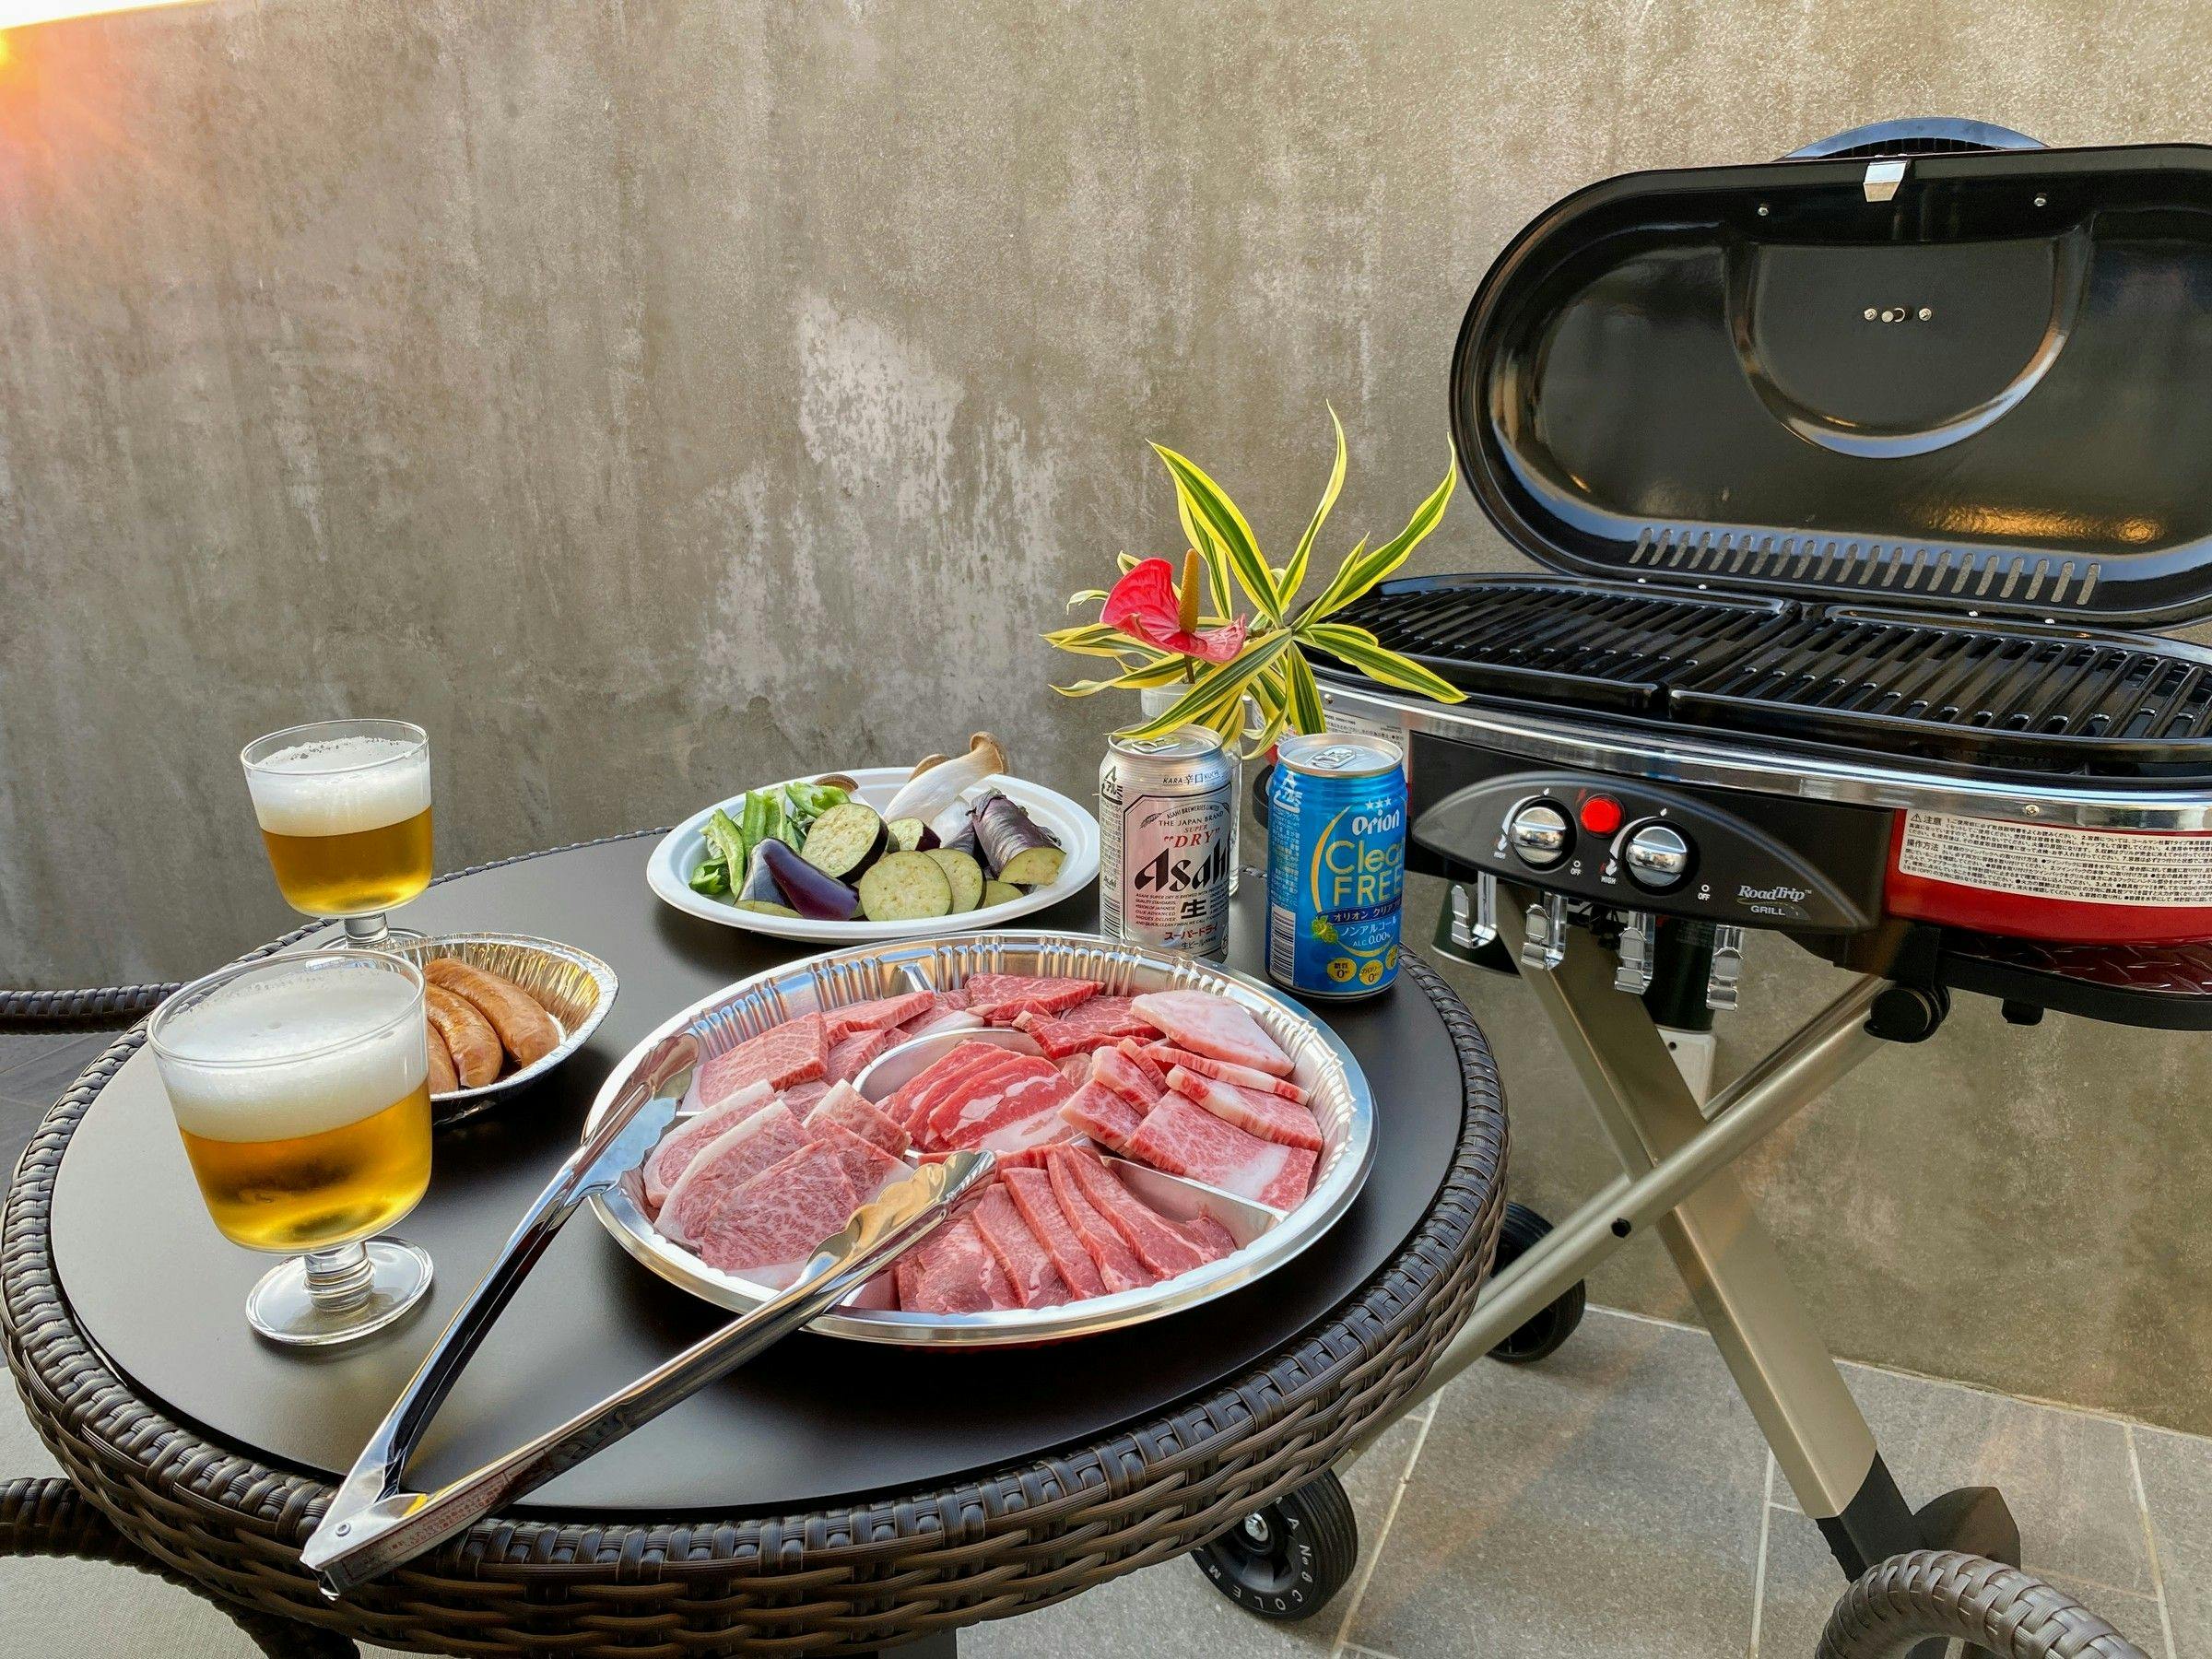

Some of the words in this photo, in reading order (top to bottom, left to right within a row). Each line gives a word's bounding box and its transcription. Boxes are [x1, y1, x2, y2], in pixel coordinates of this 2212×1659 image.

[1178, 818, 1203, 827] JAPAN
[1204, 810, 1224, 822] BRAND
[1351, 808, 1400, 836] Orion
[1183, 824, 1208, 833] SUPER
[1570, 867, 1583, 876] OFF
[1334, 863, 1403, 907] FREE
[1600, 876, 1617, 885] HIGH
[1698, 892, 1711, 901] OFF
[1181, 900, 1207, 920] 生
[1750, 905, 1786, 916] GRILL
[1334, 911, 1369, 923] オリオン
[1164, 922, 1218, 940] スーパードライ
